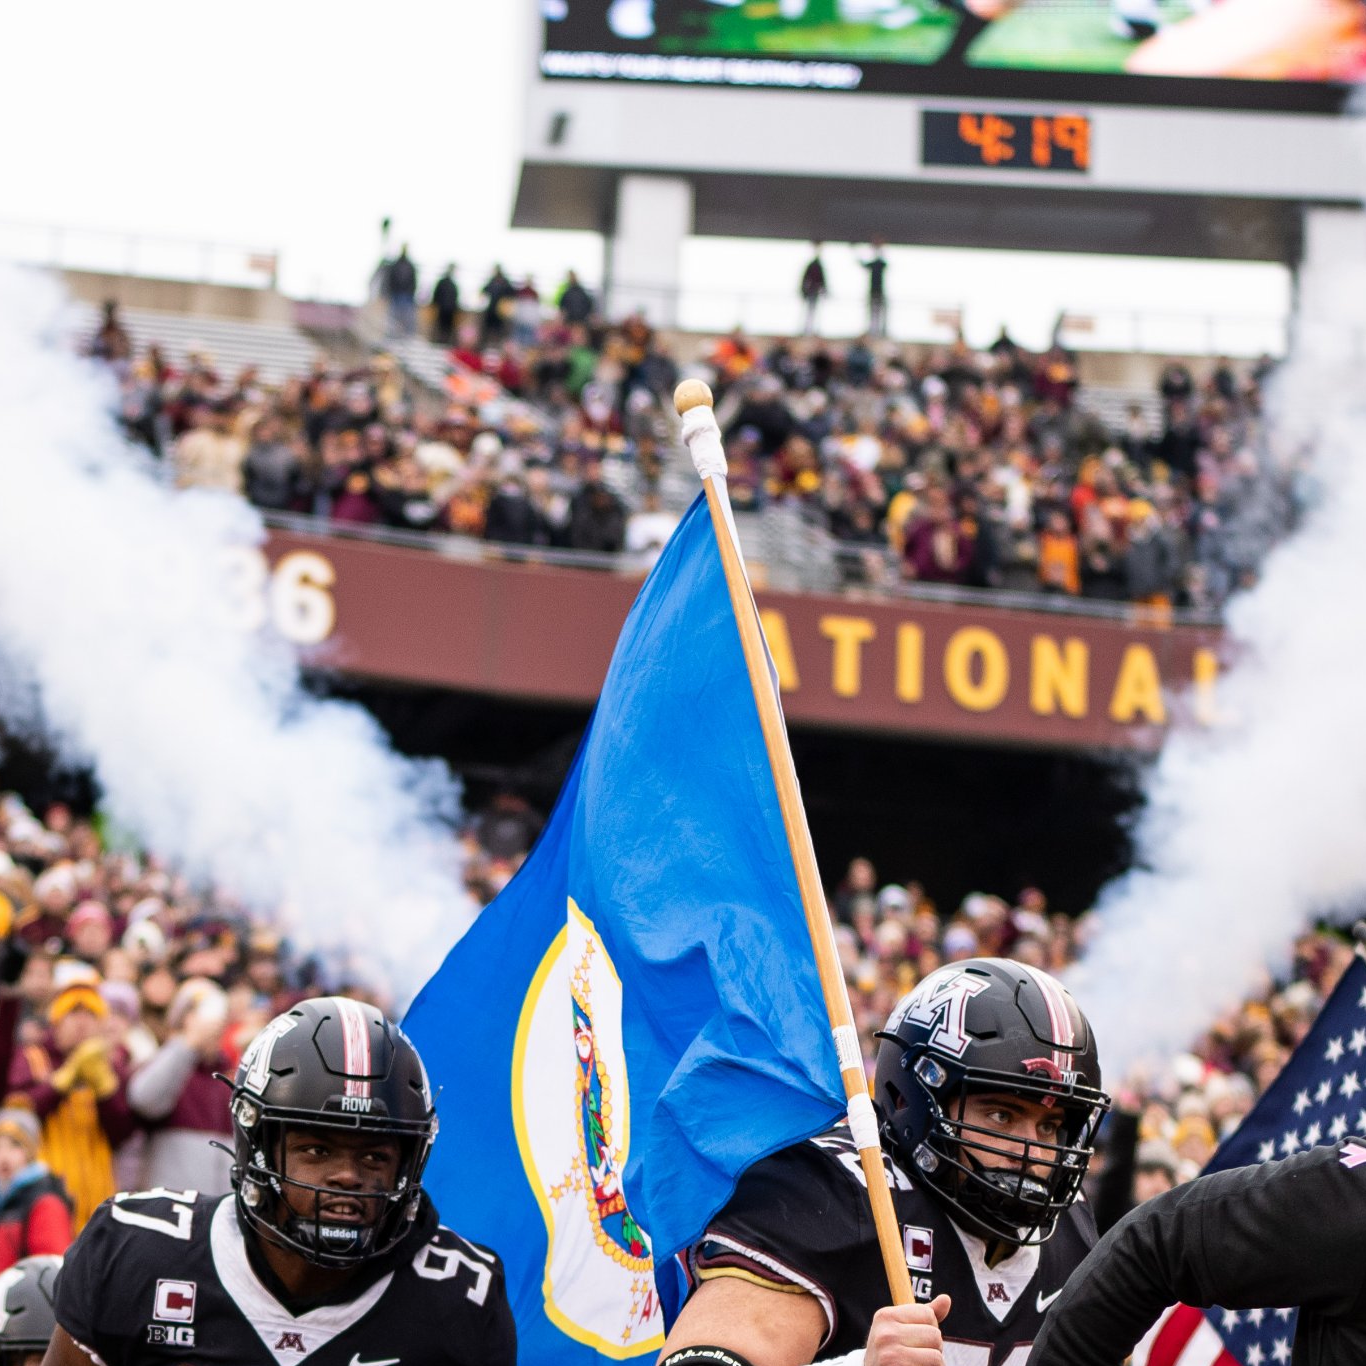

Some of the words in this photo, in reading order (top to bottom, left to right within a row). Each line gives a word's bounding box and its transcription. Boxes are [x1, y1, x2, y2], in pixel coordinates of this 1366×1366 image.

[957, 112, 1091, 171] 4:19
[341, 1097, 372, 1113] ROW
[321, 1227, 358, 1240] Riddell
